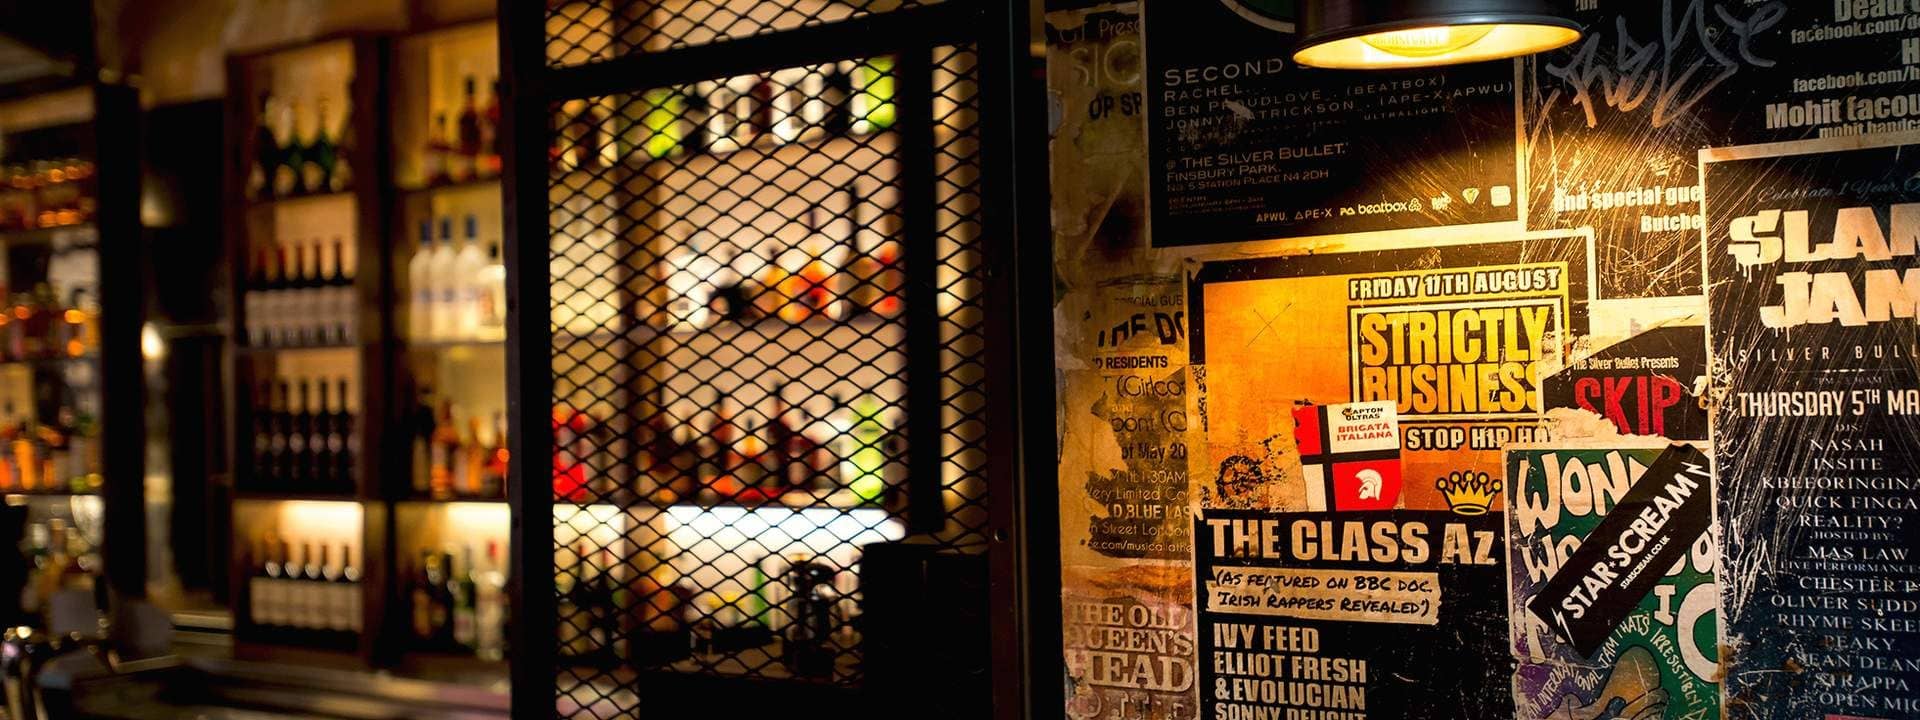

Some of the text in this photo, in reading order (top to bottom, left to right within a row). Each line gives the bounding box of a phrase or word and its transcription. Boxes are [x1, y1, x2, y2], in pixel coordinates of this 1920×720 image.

[1164, 57, 1284, 88] SECOND
[1765, 98, 1842, 129] Mohit
[1217, 150, 1275, 167] SILVER
[1590, 185, 1661, 210] special
[1358, 200, 1408, 215] beatbox
[1640, 212, 1700, 233] Butche
[1349, 277, 1419, 300] FRIDAY
[1474, 267, 1562, 295] AUGUST
[1760, 268, 1920, 342] JAM
[1360, 307, 1550, 367] STRICTLY
[1106, 355, 1168, 369] RESIDENTS
[1641, 355, 1680, 369] Presents
[1739, 346, 1830, 363] SILVER
[1574, 374, 1681, 437] SKIP
[1738, 390, 1845, 417] THURSDAY
[1851, 388, 1881, 416] 5TH
[1337, 431, 1393, 442] ITALIANA
[1338, 422, 1390, 434] BRIGATA
[1406, 425, 1466, 450] STOP
[1810, 438, 1883, 451] NASAH
[1138, 443, 1165, 463] May
[1814, 457, 1883, 471] INSITE
[1116, 486, 1161, 500] Limited
[1126, 504, 1161, 519] BLUE
[1776, 495, 1843, 511] QUICK
[1799, 514, 1904, 530] REALITY?
[1207, 518, 1281, 559] THE
[1291, 520, 1429, 564] CLASS
[1808, 545, 1909, 561] MAS LAW
[1247, 574, 1320, 590] FEATURED
[1327, 577, 1348, 590] ON
[1355, 575, 1391, 591] BBC
[1799, 576, 1896, 594] CHESTER
[1267, 594, 1335, 612] RAPPERS
[1771, 594, 1848, 611] OLIVER
[1127, 604, 1188, 630] OLD
[1778, 614, 1920, 633] RHYME SKEE
[1213, 623, 1320, 654] IVY FEED
[1823, 634, 1896, 651] PEAKY
[1067, 650, 1194, 692] HEAD
[1213, 652, 1367, 684] ELLIOT FRESH
[1819, 692, 1876, 708] OPEN
[1215, 702, 1281, 720] SONNY
